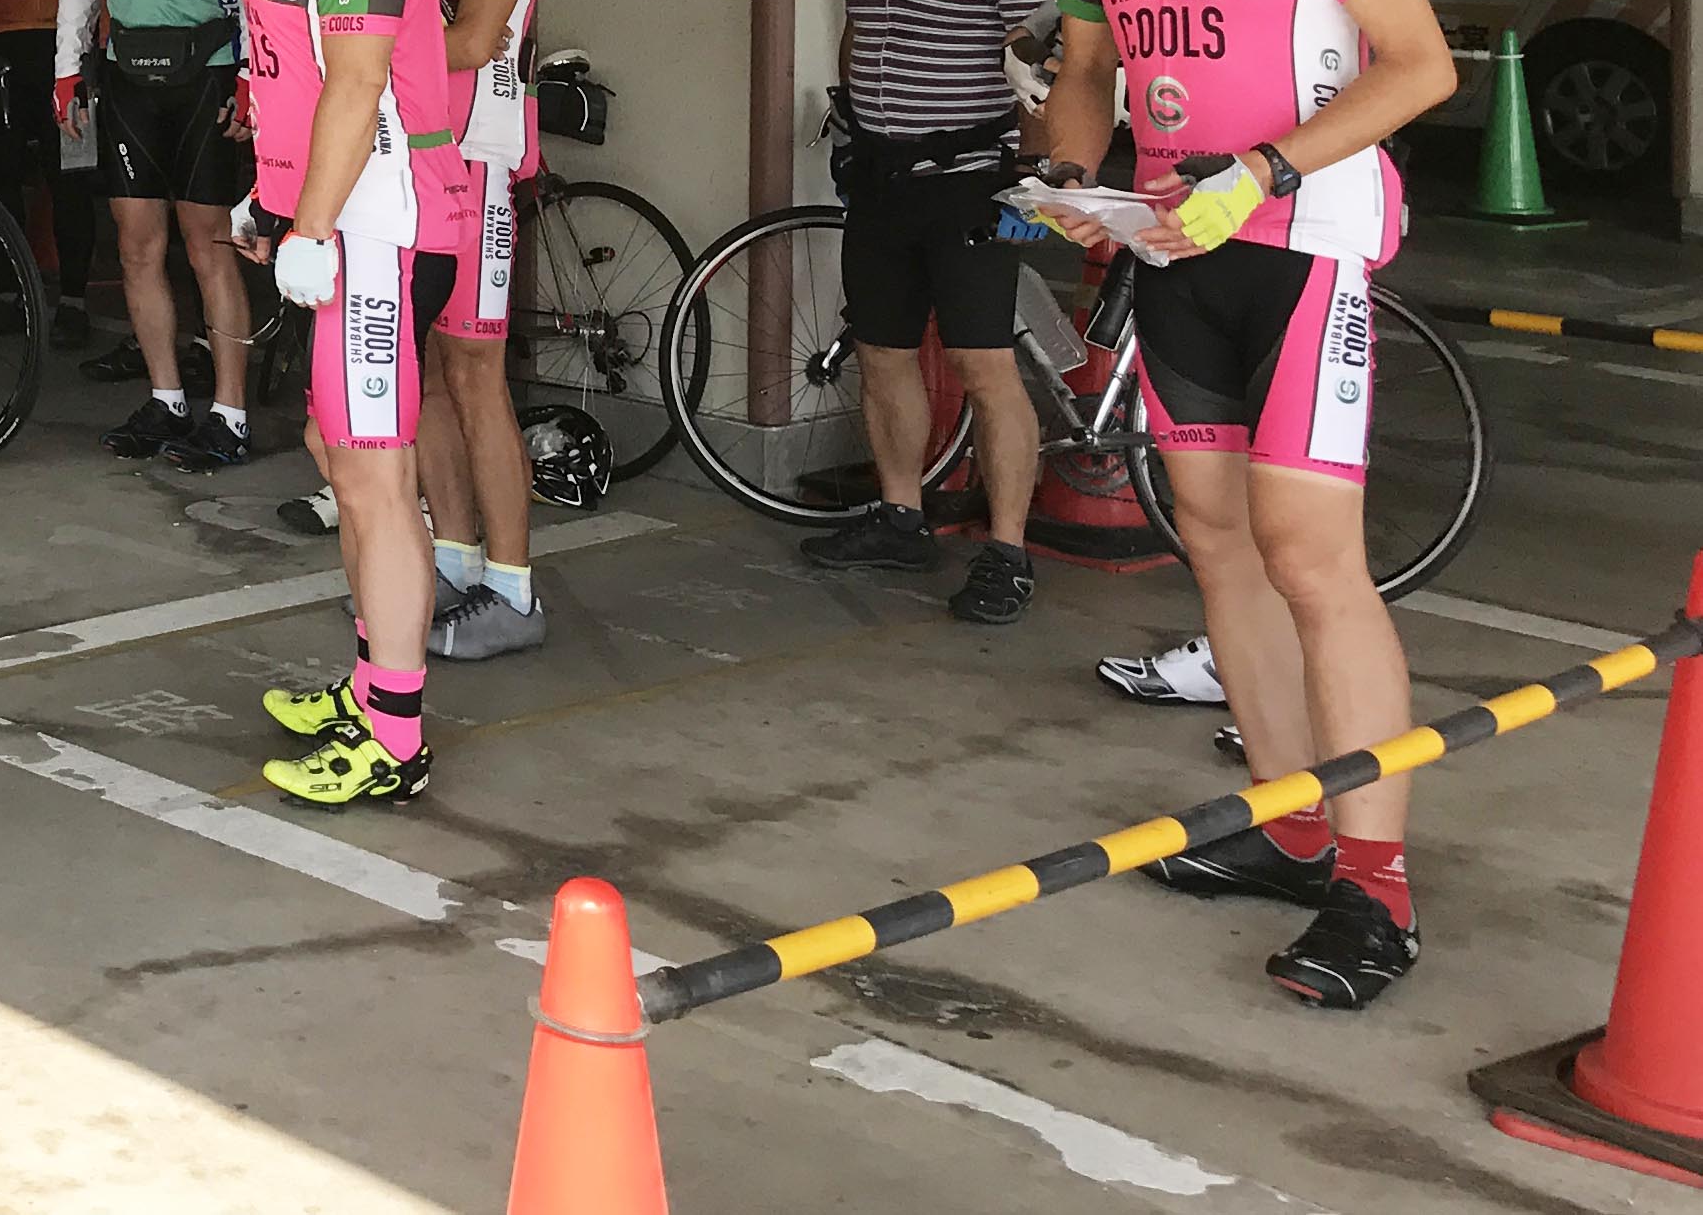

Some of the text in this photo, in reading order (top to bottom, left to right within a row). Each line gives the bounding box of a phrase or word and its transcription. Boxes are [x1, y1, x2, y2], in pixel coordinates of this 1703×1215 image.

[329, 17, 364, 32] COOLS
[1118, 6, 1226, 61] COOLS
[486, 205, 497, 260] SHIBAKAWA
[495, 206, 512, 260] COOLS
[350, 294, 363, 364] SHIBAKAWA
[364, 297, 396, 365] COOLS
[475, 321, 503, 335] COOLS
[1328, 292, 1350, 364] SHIBAKAWA
[1341, 296, 1368, 368] COOLS
[1172, 427, 1217, 443] COOLS
